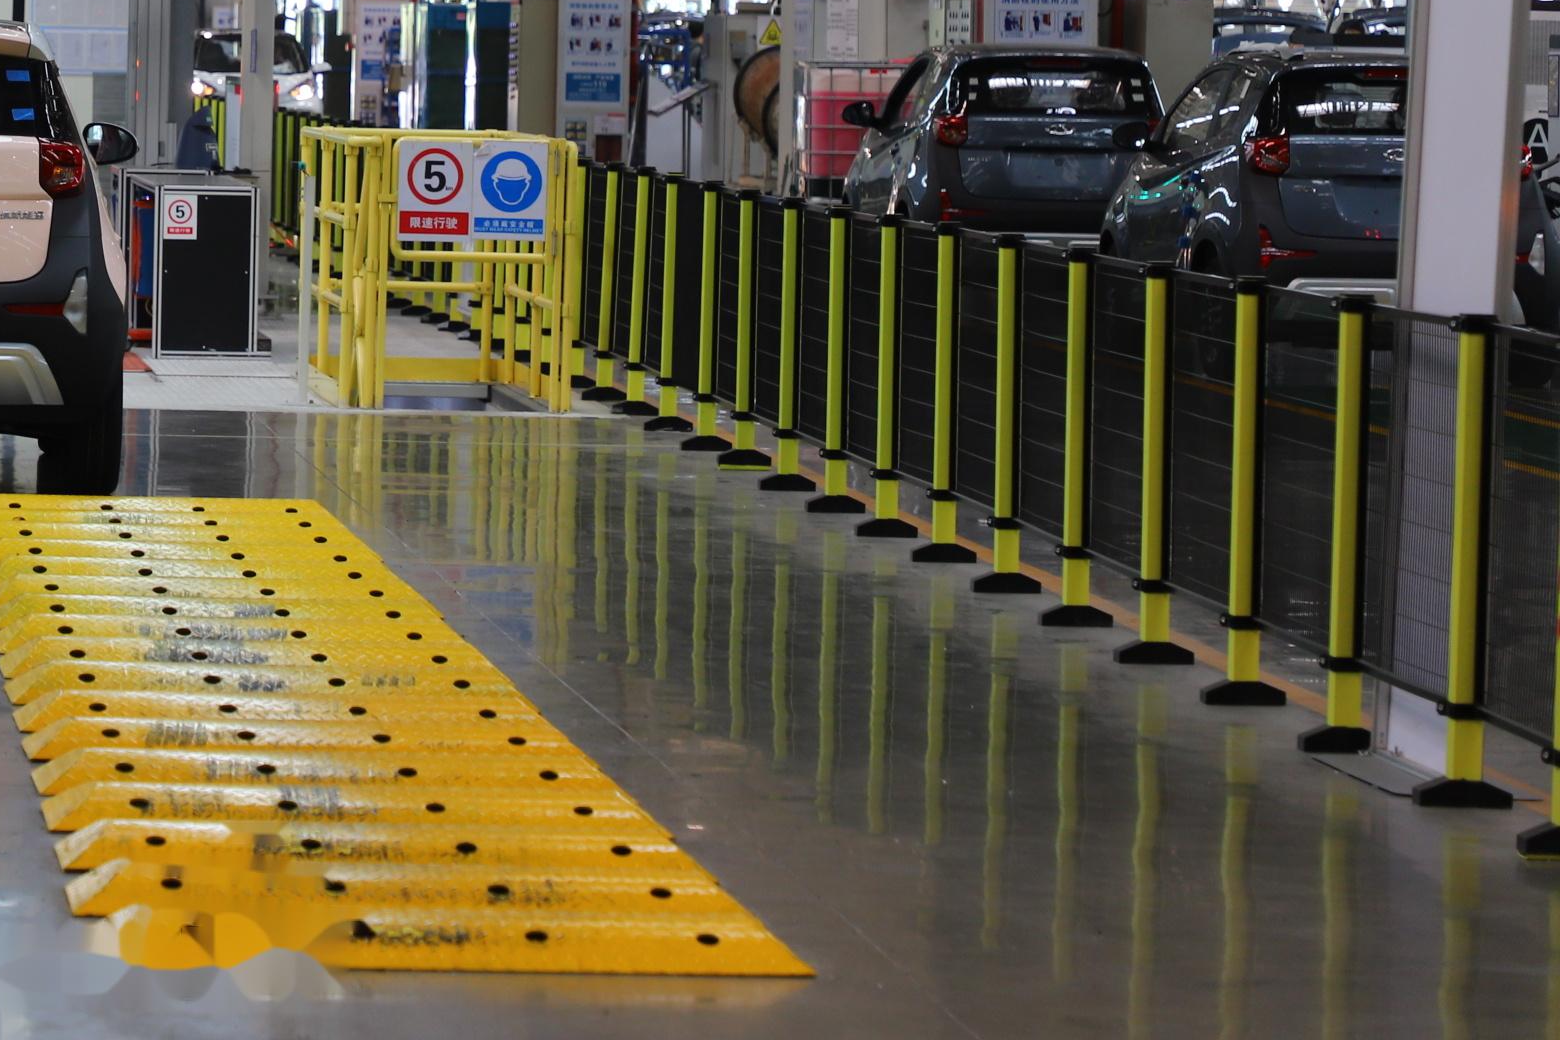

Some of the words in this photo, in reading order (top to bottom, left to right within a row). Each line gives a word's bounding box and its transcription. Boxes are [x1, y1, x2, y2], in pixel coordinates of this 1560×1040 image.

[424, 160, 446, 193] 5
[176, 205, 185, 219] 5
[409, 216, 458, 229] 限速行驶
